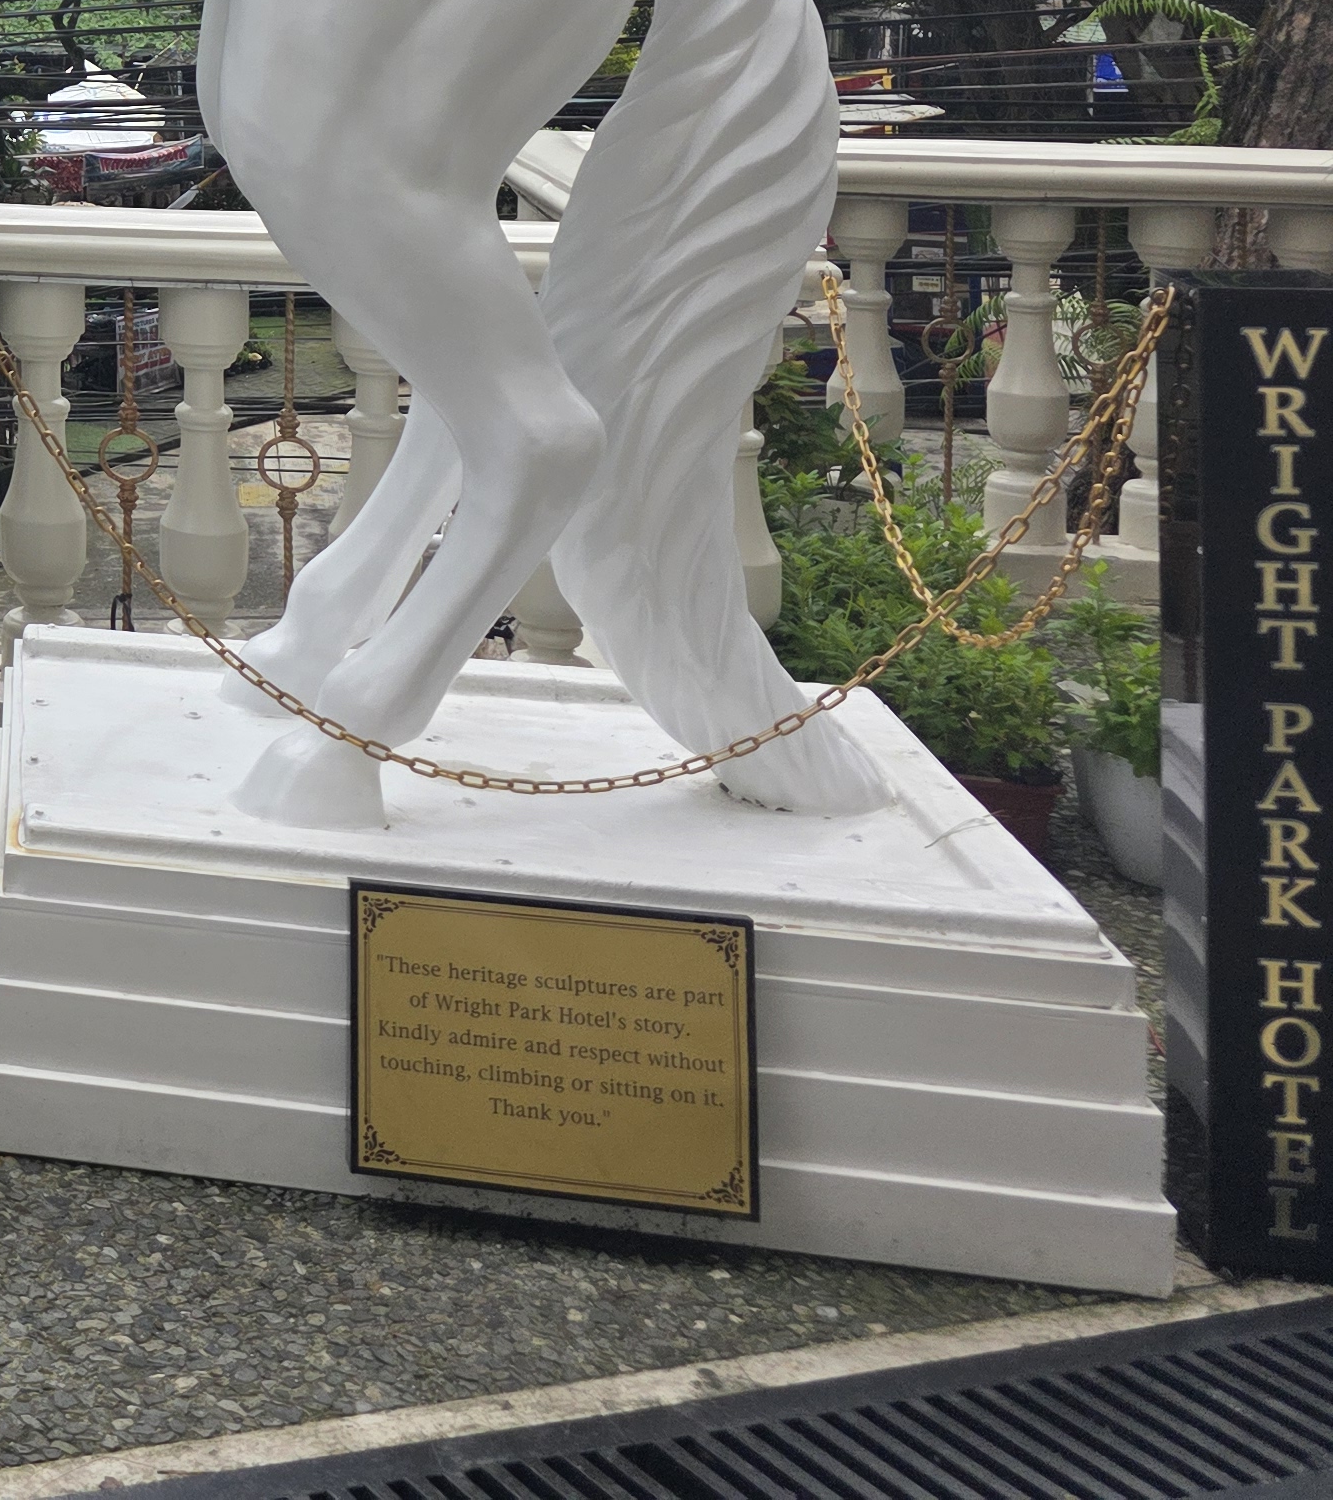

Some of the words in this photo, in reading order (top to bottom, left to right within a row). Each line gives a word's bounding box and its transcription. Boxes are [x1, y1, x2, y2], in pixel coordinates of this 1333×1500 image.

[1240, 326, 1329, 671] WRIGHT
[1256, 702, 1323, 930] PARK
[376, 954, 441, 977] "These
[448, 963, 528, 988] heritage
[534, 973, 638, 999] sculptures
[645, 986, 675, 1001] are
[683, 989, 724, 1008] part
[409, 991, 431, 1009] of
[435, 993, 501, 1019] Wright
[509, 1002, 552, 1021] Park
[559, 1008, 627, 1030] Hotel's
[634, 1019, 690, 1039] story.
[378, 1019, 441, 1045] Kindly
[448, 1030, 517, 1051] admire
[524, 1039, 561, 1056] and
[568, 1043, 640, 1066] respect
[647, 1052, 725, 1073] without
[380, 1054, 471, 1081] touching,
[478, 1065, 564, 1092] climbing
[570, 1076, 593, 1092] or
[599, 1079, 664, 1104] sitting
[670, 1089, 695, 1104] on
[702, 1089, 724, 1107] it.
[1257, 958, 1322, 1242] HOTEL
[489, 1097, 552, 1120] Thank
[558, 1109, 610, 1128] you."
